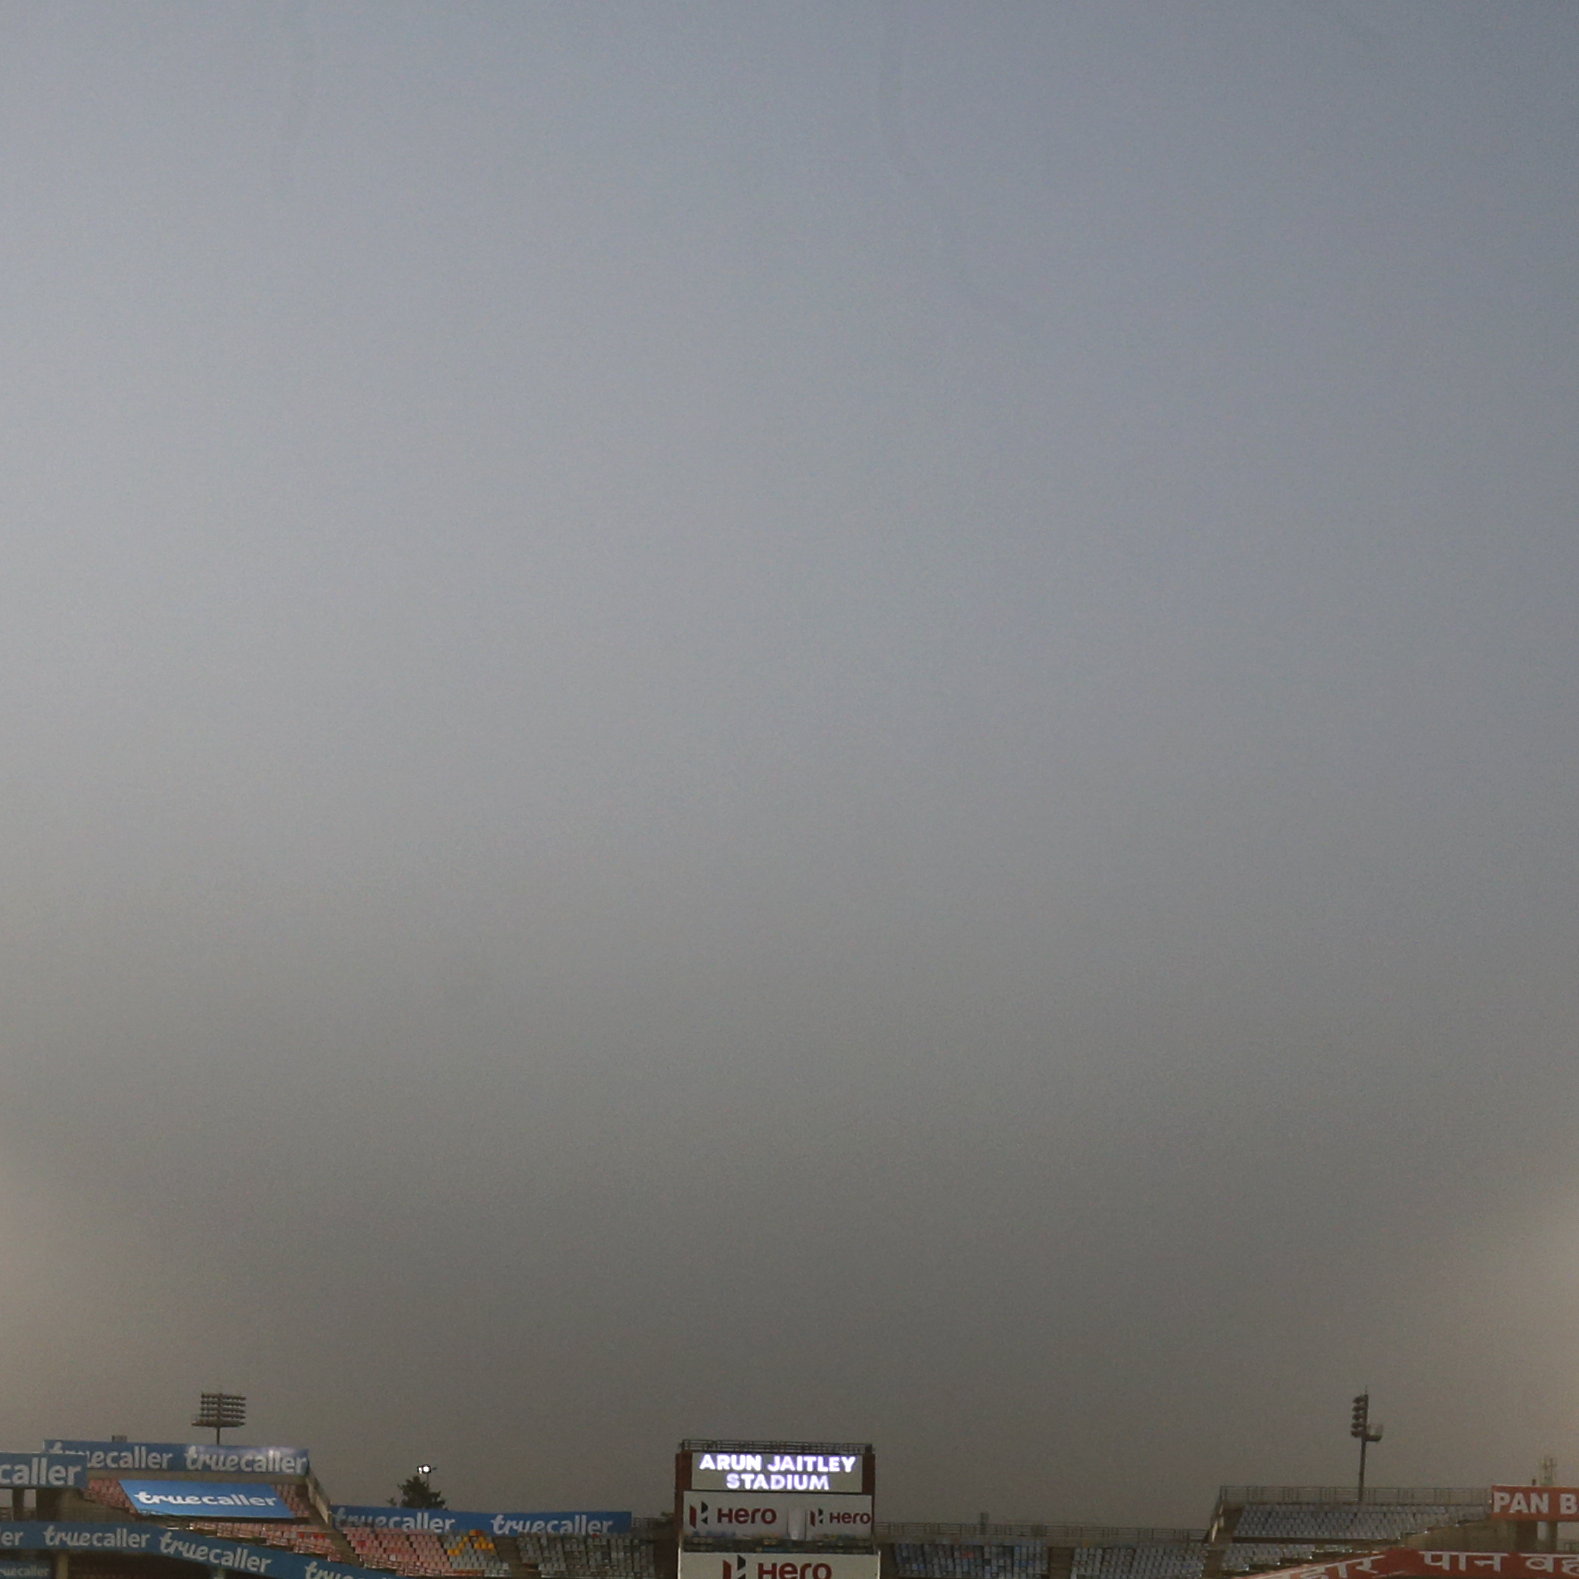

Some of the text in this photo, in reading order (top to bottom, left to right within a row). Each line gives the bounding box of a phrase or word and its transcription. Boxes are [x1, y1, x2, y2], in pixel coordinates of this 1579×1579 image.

[186, 1446, 307, 1474] truecaller
[699, 1454, 856, 1473] ARUN JAITLEY
[726, 1474, 830, 1491] STADIUM
[135, 1491, 278, 1507] truecaller
[1494, 1491, 1550, 1514] PAN
[44, 1526, 150, 1548] truecaller
[160, 1532, 272, 1572] truecaller
[1419, 1551, 1509, 1571] पान
